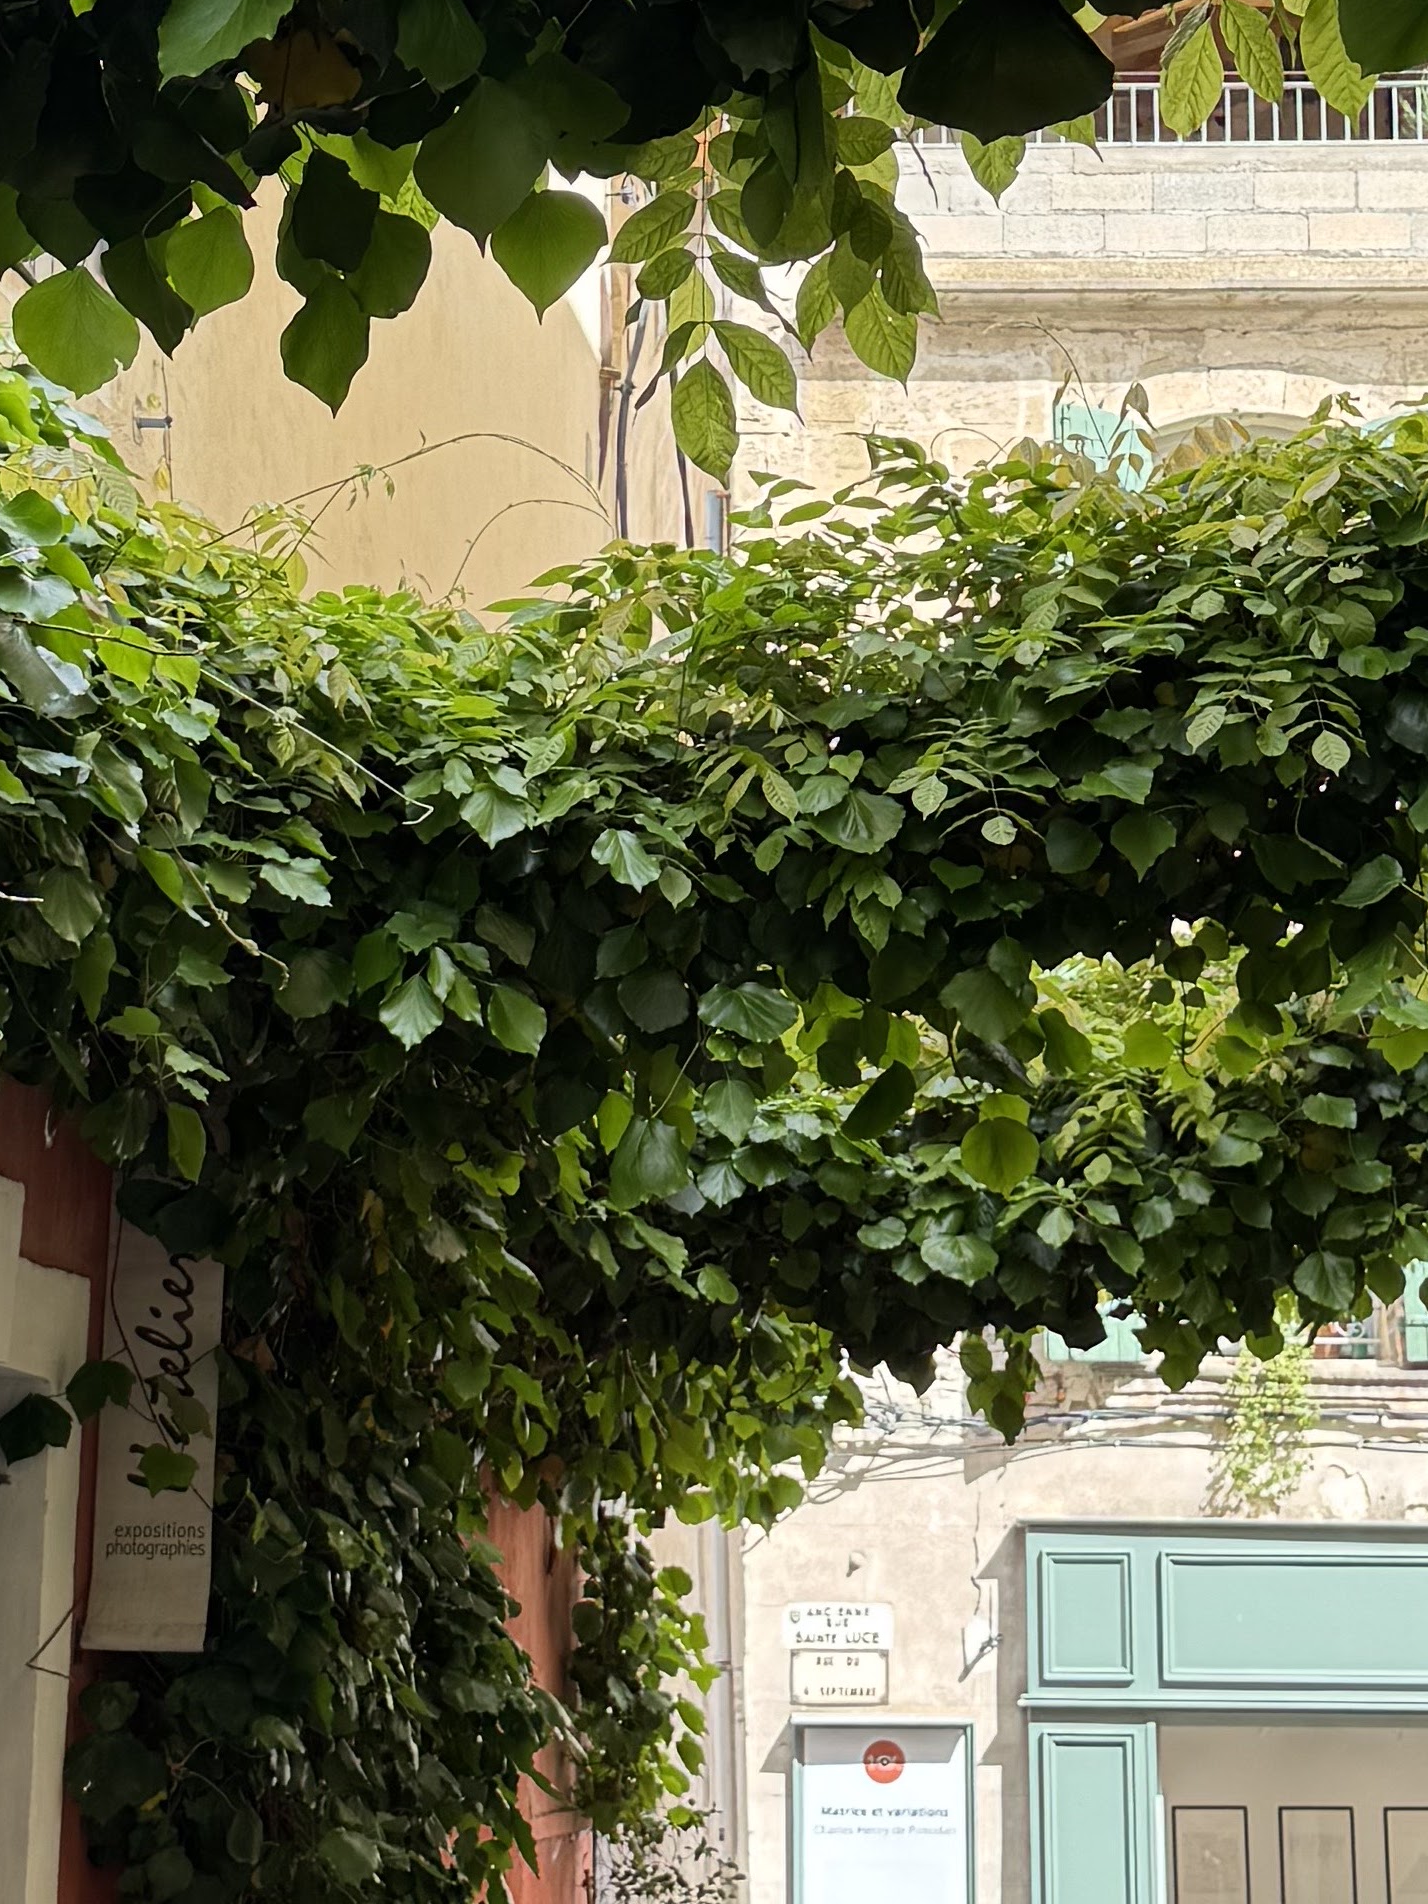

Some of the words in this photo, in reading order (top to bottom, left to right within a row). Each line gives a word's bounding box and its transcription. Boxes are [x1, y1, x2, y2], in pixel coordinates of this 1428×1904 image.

[114, 1521, 205, 1542] expositions
[105, 1537, 206, 1560] photographies
[845, 1631, 880, 1644] LUCE
